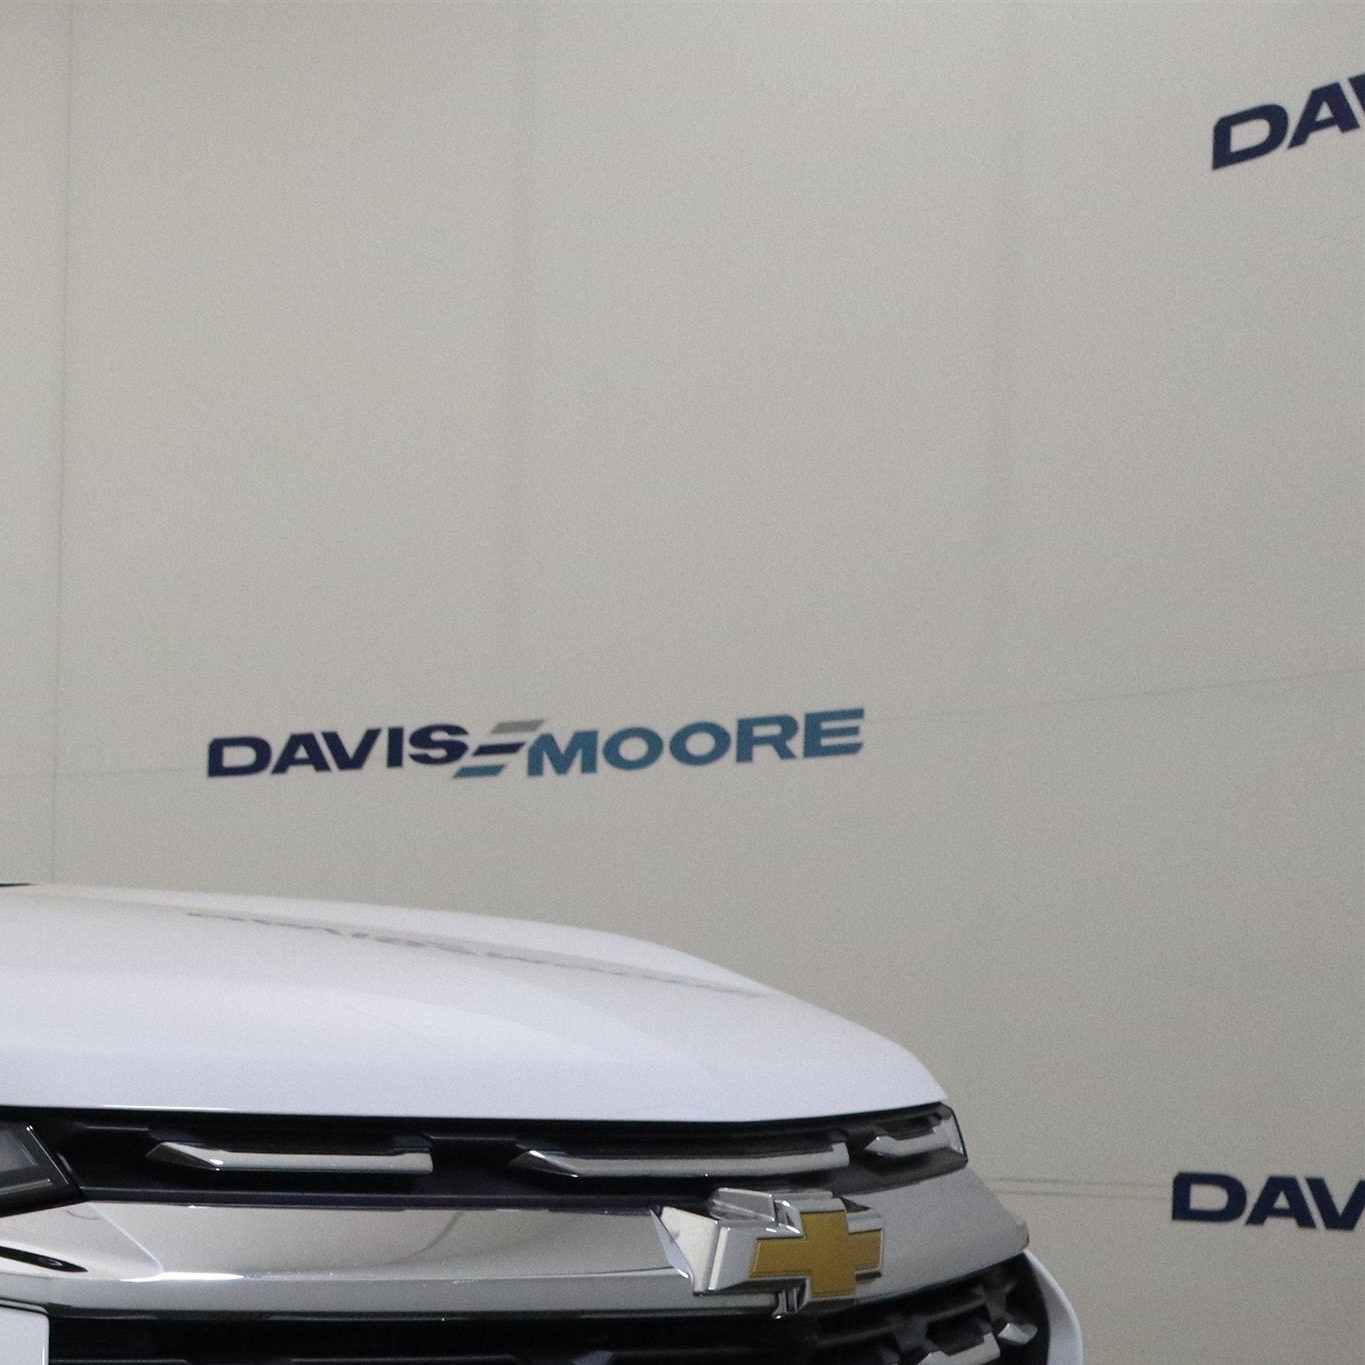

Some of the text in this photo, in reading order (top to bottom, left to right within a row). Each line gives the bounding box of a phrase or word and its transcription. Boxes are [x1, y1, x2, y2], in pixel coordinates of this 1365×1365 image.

[1212, 73, 1365, 171] DA
[207, 708, 865, 778] DAVIS MOORE
